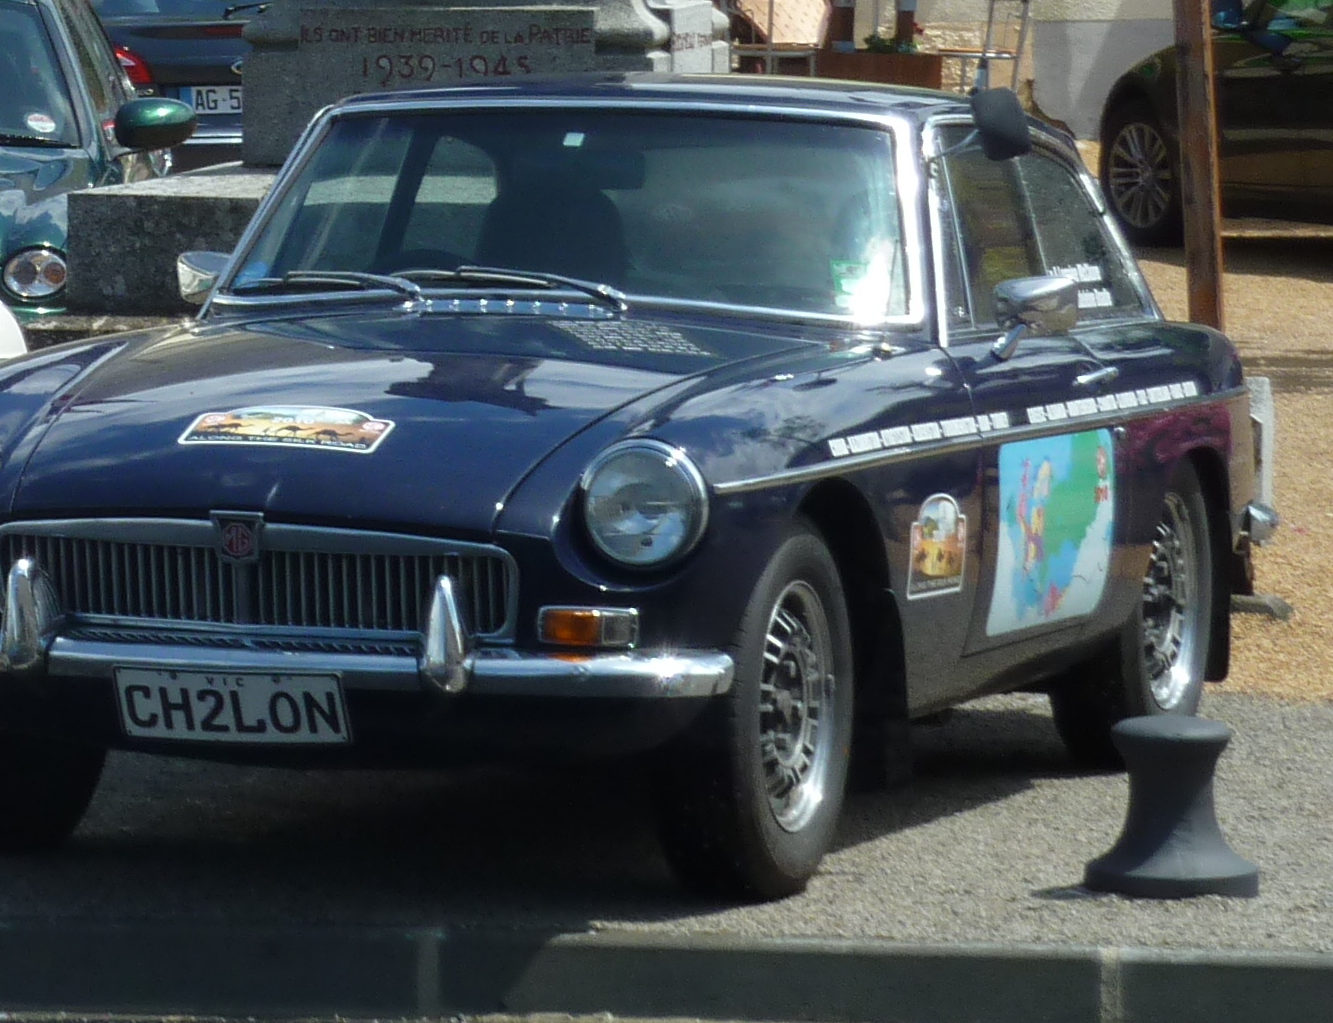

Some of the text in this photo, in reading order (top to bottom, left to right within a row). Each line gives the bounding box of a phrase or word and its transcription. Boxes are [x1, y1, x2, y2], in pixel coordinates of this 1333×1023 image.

[300, 25, 324, 44] ILS
[333, 26, 363, 44] ONT
[369, 25, 405, 44] BIEN
[479, 31, 501, 45] DE
[504, 31, 524, 44] LA
[528, 24, 591, 45] PATRIE
[361, 54, 532, 87] 1939-1945
[321, 440, 367, 450] ROAD
[124, 685, 342, 735] CH2LON
